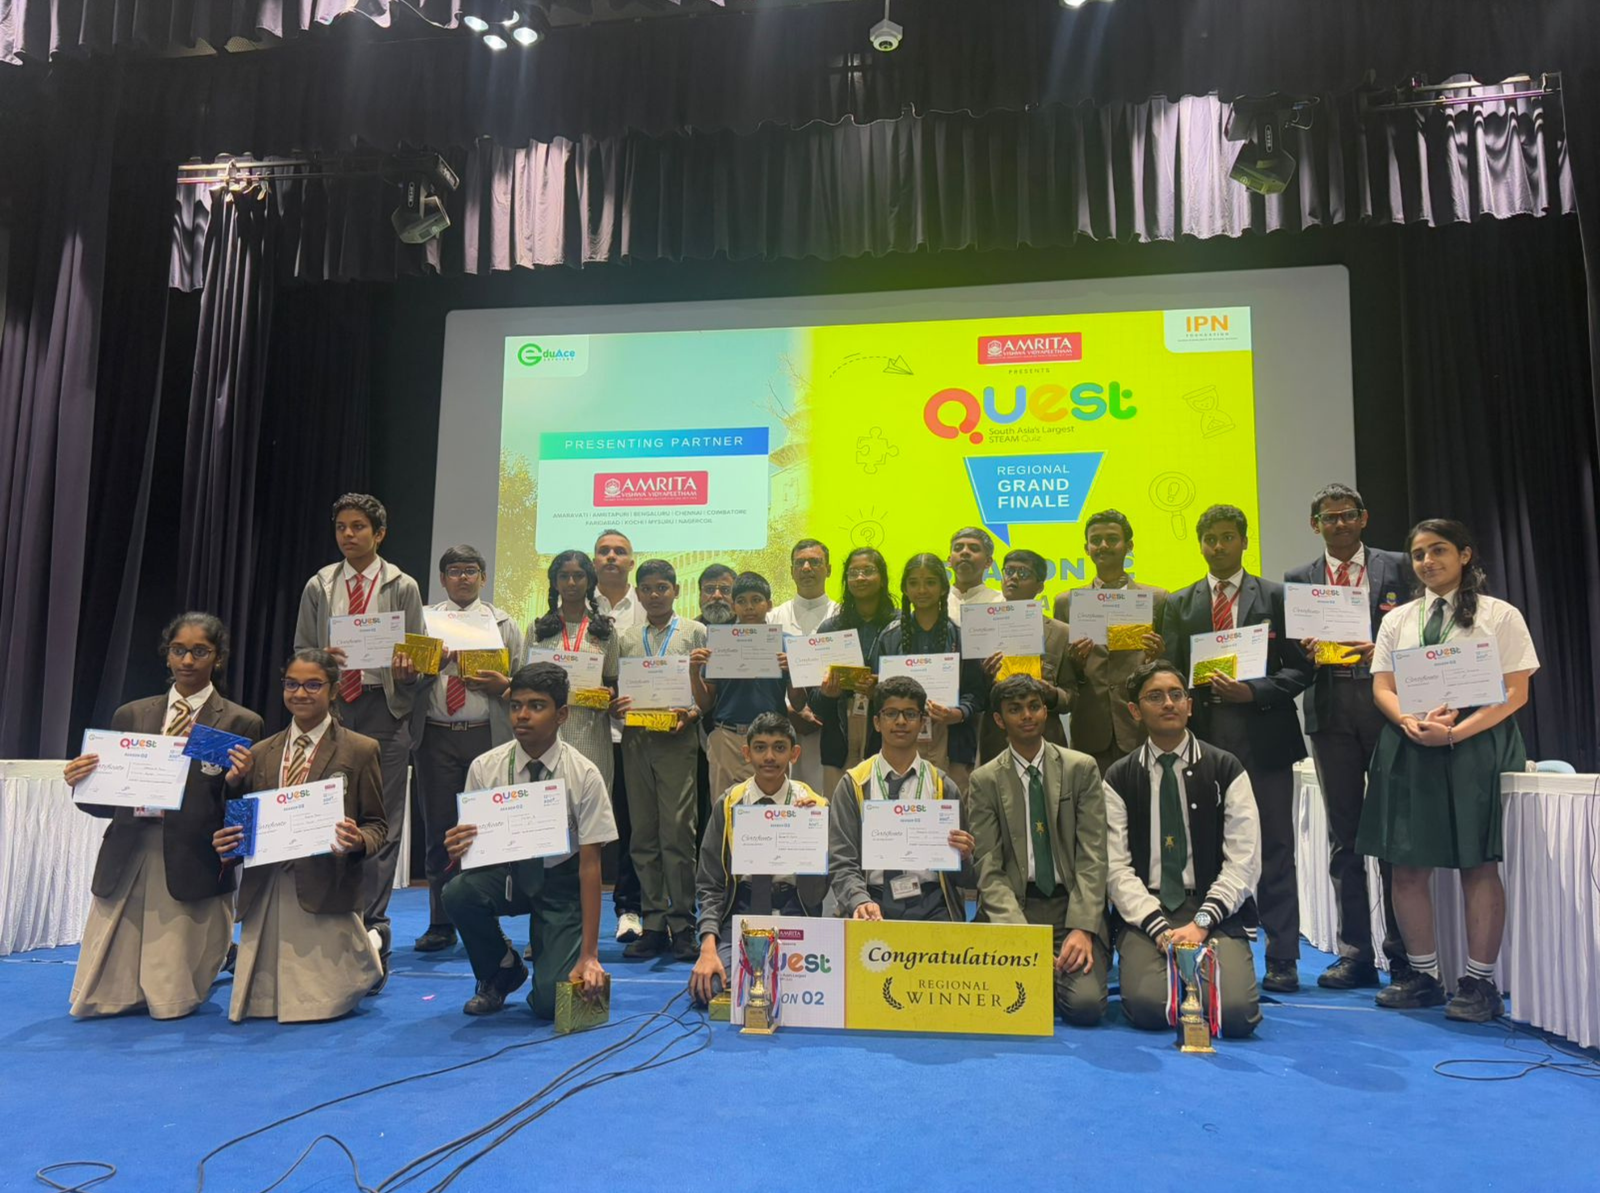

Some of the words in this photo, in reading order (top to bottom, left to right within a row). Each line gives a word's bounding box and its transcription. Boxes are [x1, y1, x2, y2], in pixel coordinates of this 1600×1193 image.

[1186, 315, 1229, 332] IPN
[1003, 337, 1072, 351] AMRITA
[988, 427, 1015, 436] South
[1016, 426, 1040, 435] Asia's
[1042, 425, 1075, 437] Largest
[565, 438, 664, 450] PRESENTING
[671, 436, 743, 448] PARTNER
[988, 435, 1019, 444] STEAM
[1021, 434, 1041, 443] Quiz
[997, 464, 1070, 476] REGIONAL
[621, 476, 698, 492] AMRITA
[998, 478, 1069, 493] GRAND
[998, 494, 1070, 509] FINALE
[868, 946, 1039, 970] Congratulations!
[918, 979, 989, 991] REGIONAL
[801, 990, 825, 1005] 02
[906, 991, 1002, 1007] WINNER
